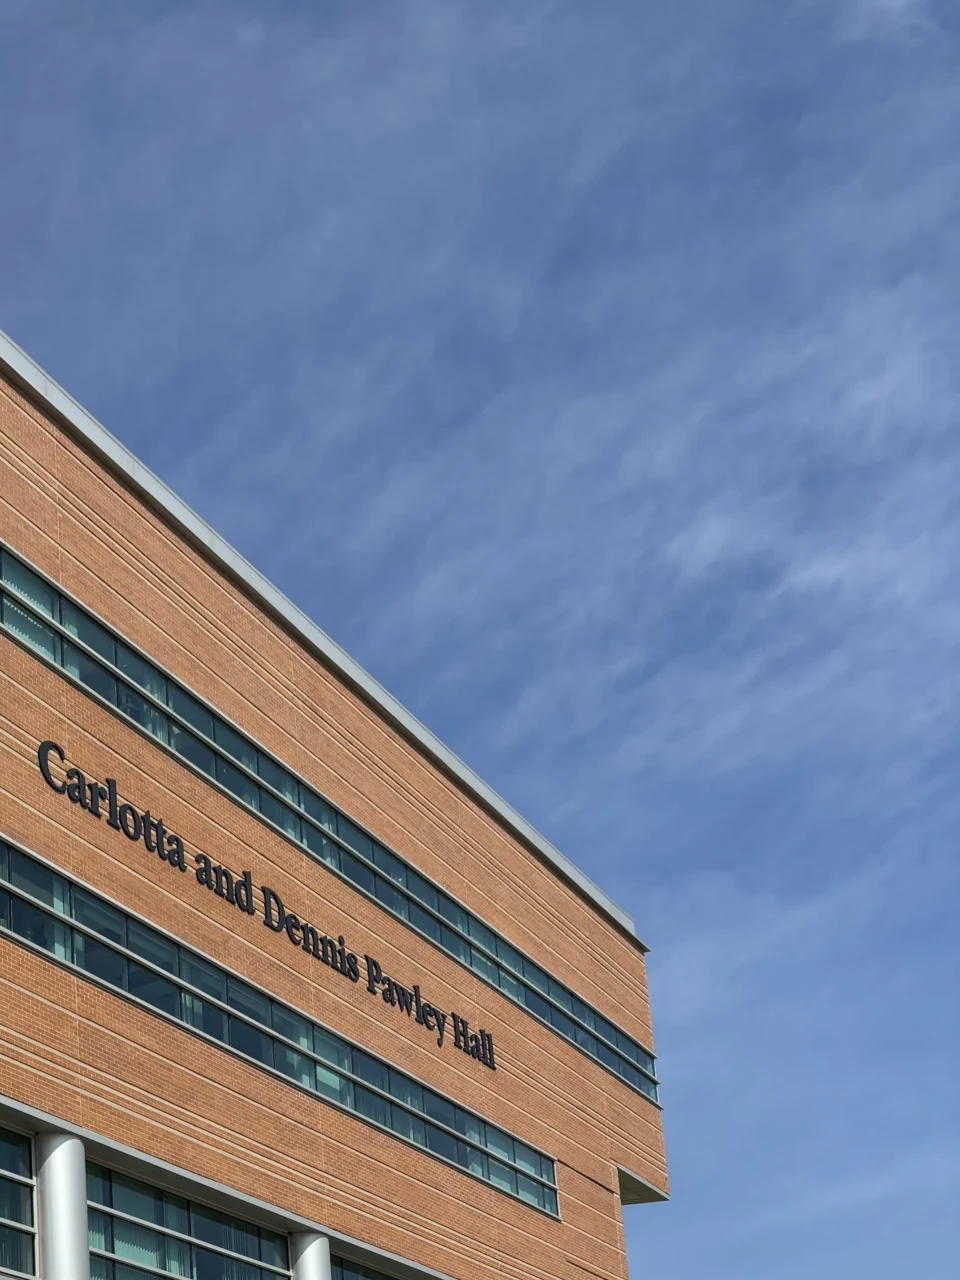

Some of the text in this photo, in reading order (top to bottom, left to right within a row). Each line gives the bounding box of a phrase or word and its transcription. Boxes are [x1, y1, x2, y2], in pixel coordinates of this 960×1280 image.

[38, 740, 496, 1070] Carlotta and Dennis Pawley Hall
